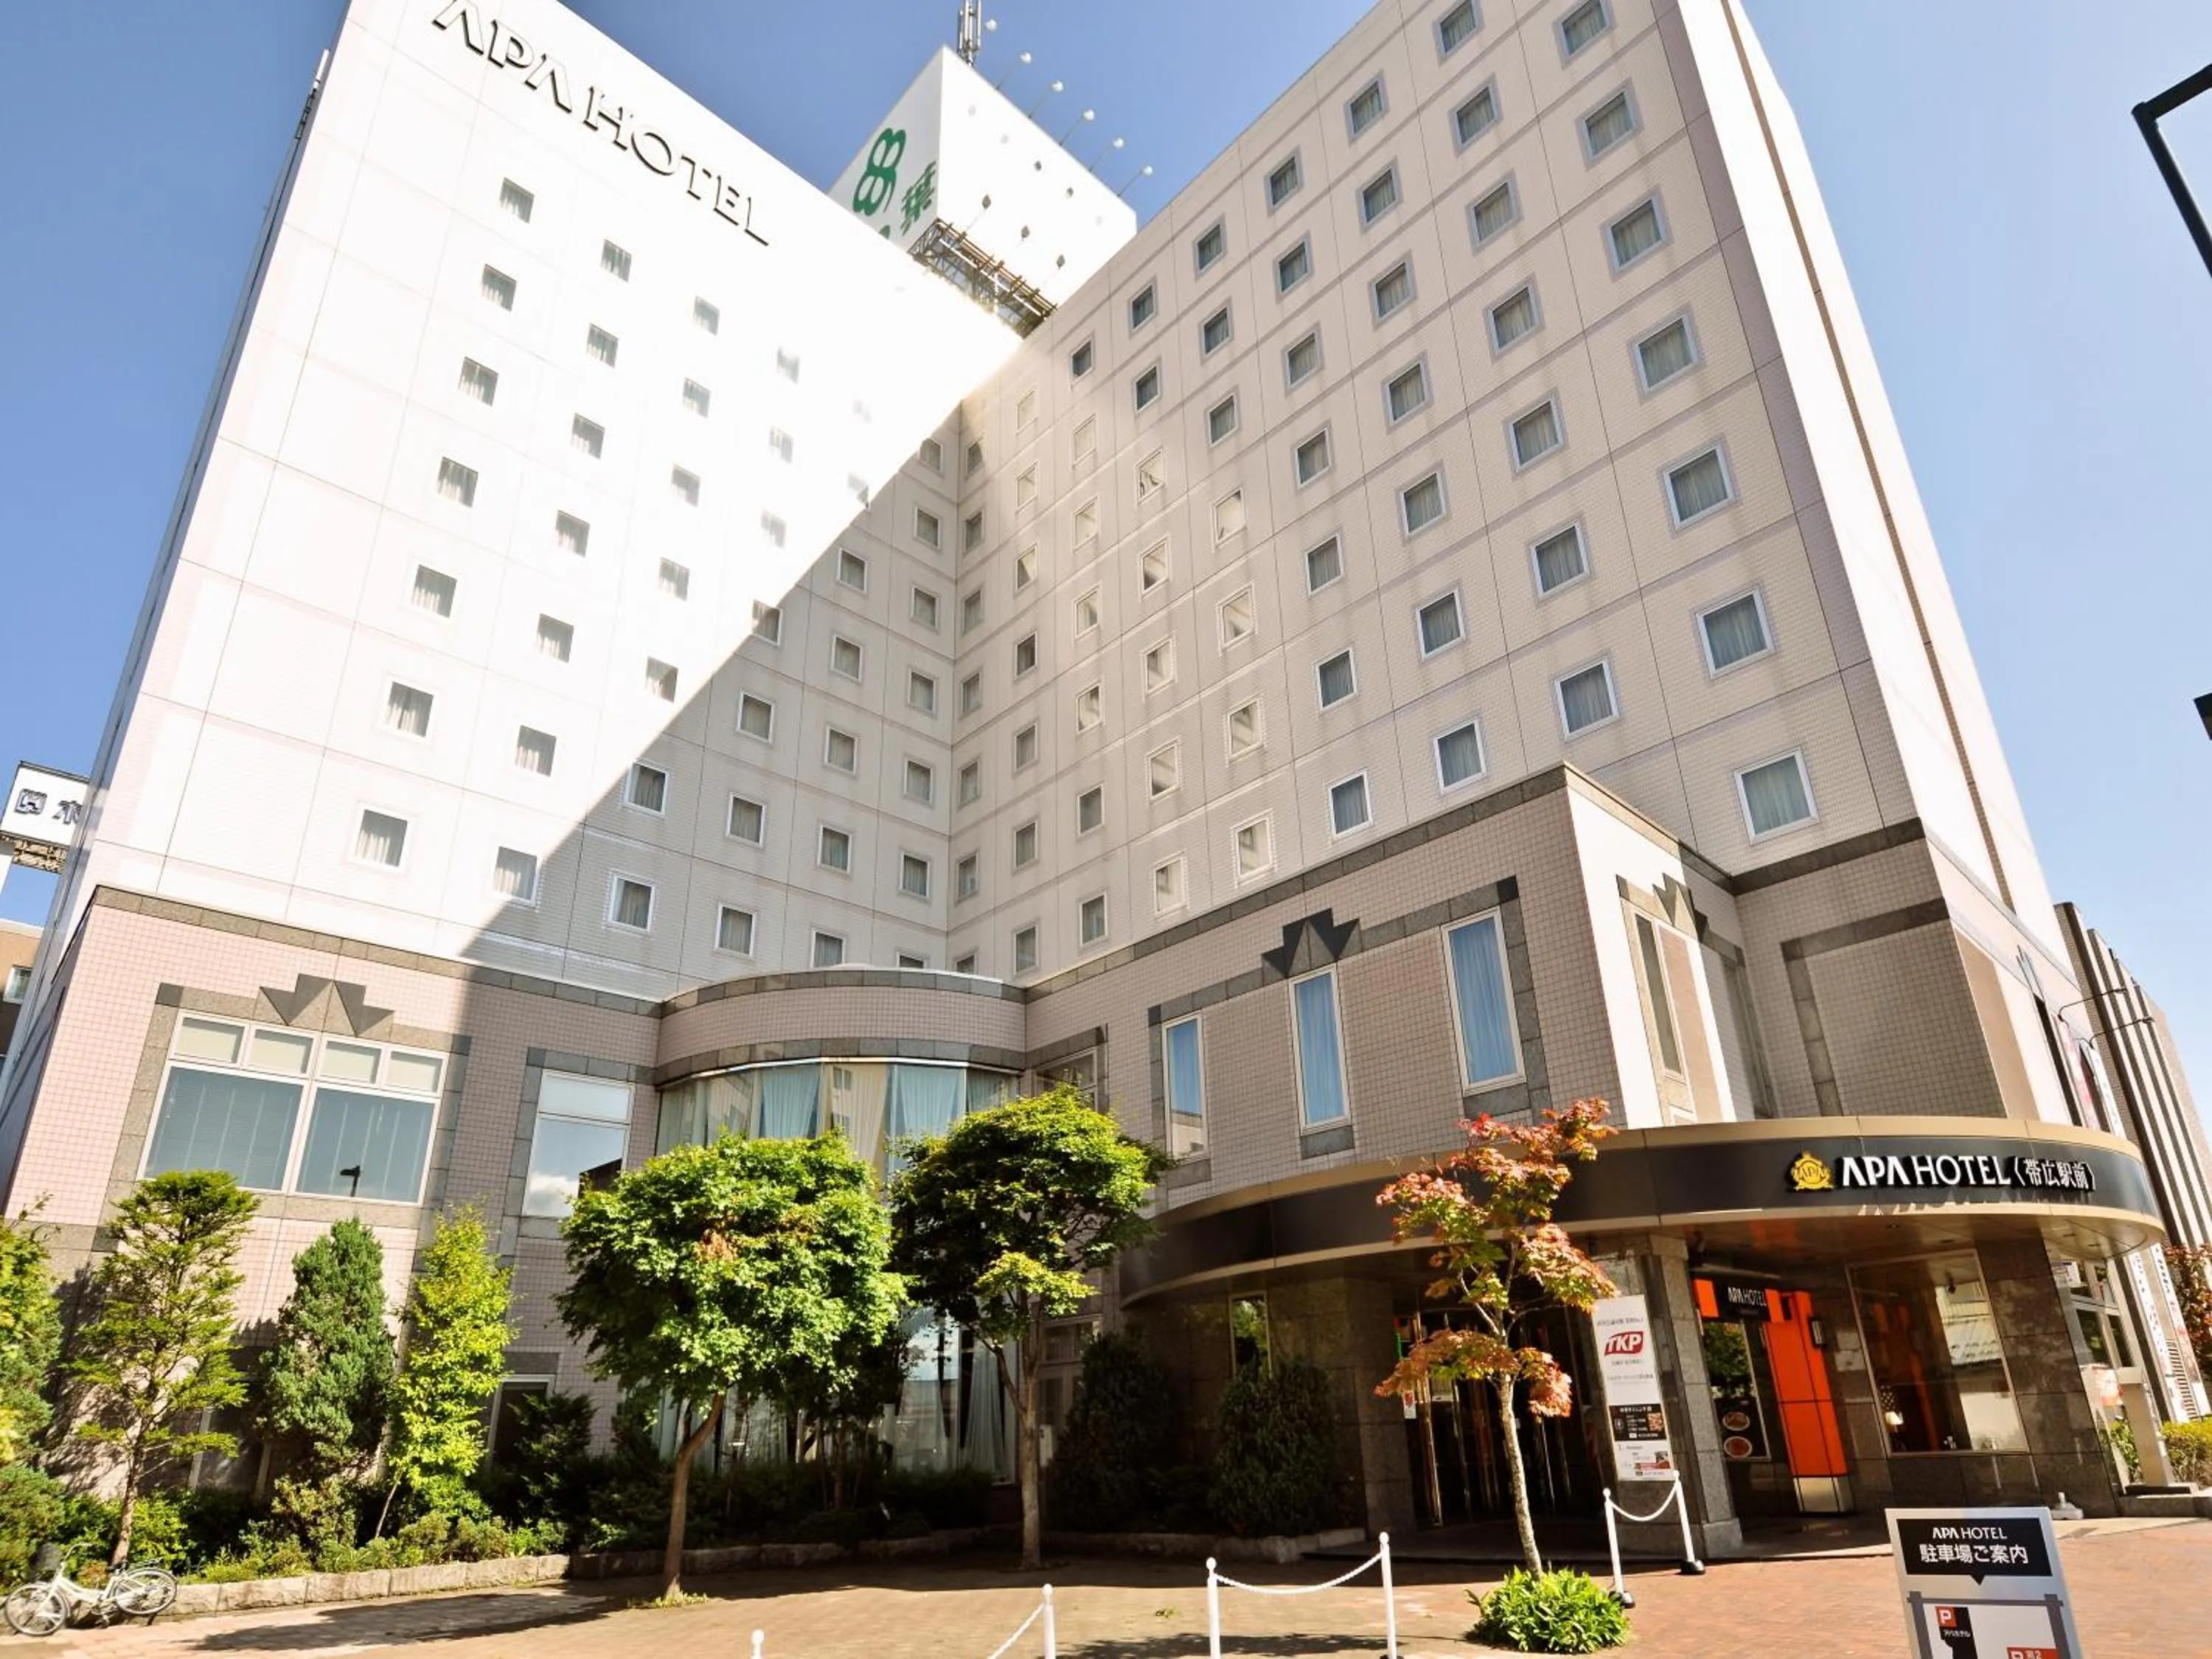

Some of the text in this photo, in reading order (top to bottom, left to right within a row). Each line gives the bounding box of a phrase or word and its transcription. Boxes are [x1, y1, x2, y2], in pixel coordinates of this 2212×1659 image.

[432, 0, 769, 246] APA HOTEL
[1843, 1156, 1907, 1186] APA
[1911, 1155, 2011, 1186] HOTEL
[1607, 1333, 1642, 1353] TKP
[1933, 1527, 2008, 1540] APA HOTEL
[1919, 1543, 2029, 1564] 駐車場ご案内
[1939, 1610, 1952, 1624] P
